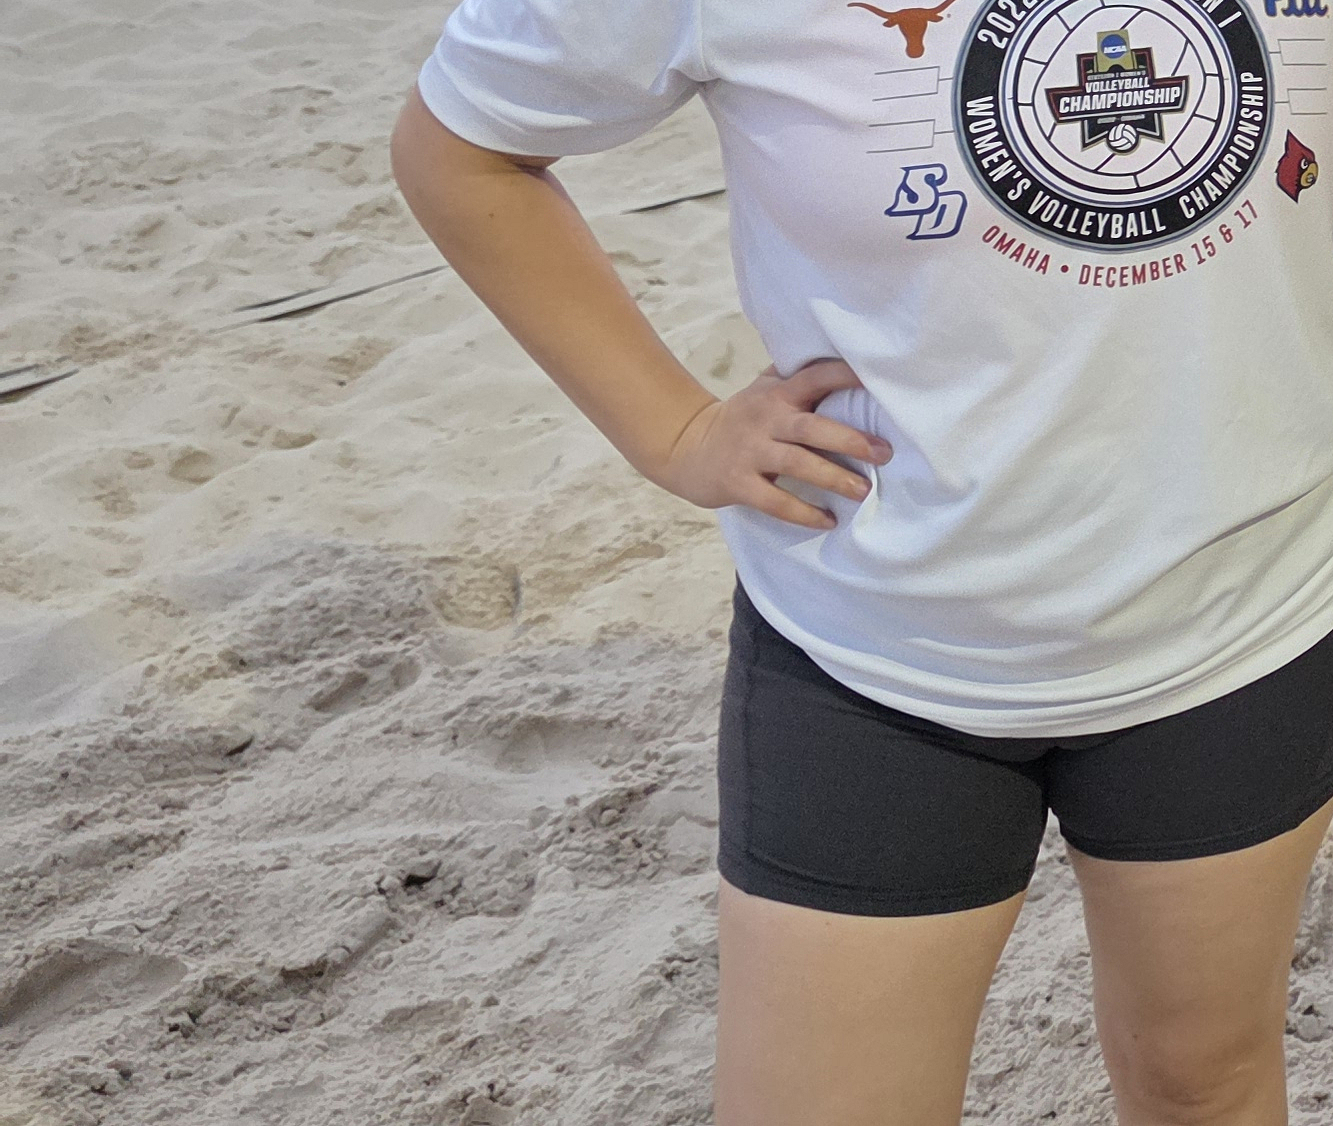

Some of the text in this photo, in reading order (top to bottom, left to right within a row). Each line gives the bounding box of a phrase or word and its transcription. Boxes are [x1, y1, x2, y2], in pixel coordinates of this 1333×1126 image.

[1218, 10, 1242, 29] I
[1085, 77, 1150, 93] VOLLEYBALL
[1059, 86, 1181, 114] CHAMPIONSHIP
[966, 72, 1264, 240] WOMEN'S VOLLEYBALL CHAMPIONSHIP
[982, 199, 1259, 288] OMAHA DECEMBER 15 & 17
